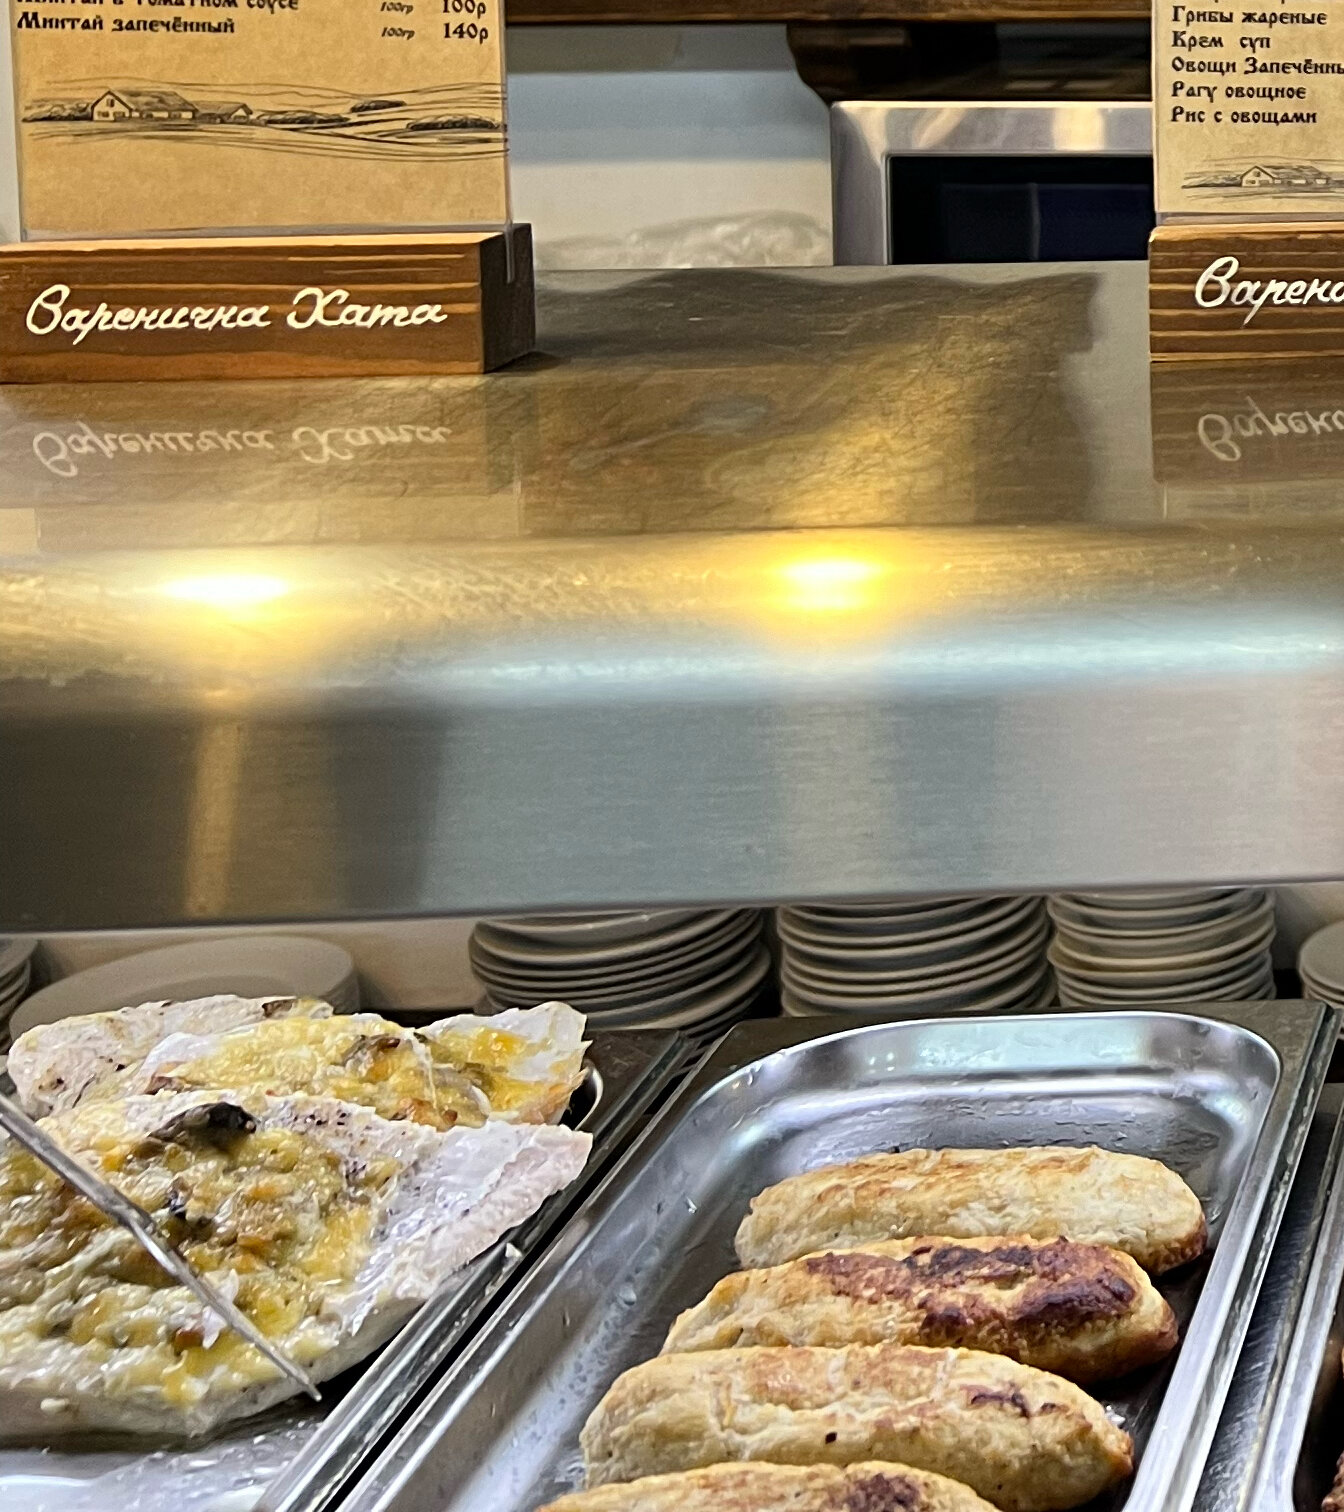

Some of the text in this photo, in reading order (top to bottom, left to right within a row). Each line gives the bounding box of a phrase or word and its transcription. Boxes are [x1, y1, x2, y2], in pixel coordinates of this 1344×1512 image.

[16, 11, 104, 31] Минтай
[111, 16, 235, 34] запечённый
[443, 22, 489, 45] 140р
[1171, 5, 1234, 27] Грибы
[1241, 11, 1327, 29] жареные
[1171, 30, 1224, 53] Крем
[1239, 36, 1271, 54] суп
[1171, 56, 1237, 77] Овощи
[1171, 80, 1218, 104] Рагу
[1224, 86, 1307, 102] овощное
[1170, 105, 1206, 123] Рис
[1213, 110, 1223, 124] с
[1230, 111, 1318, 127] овощами
